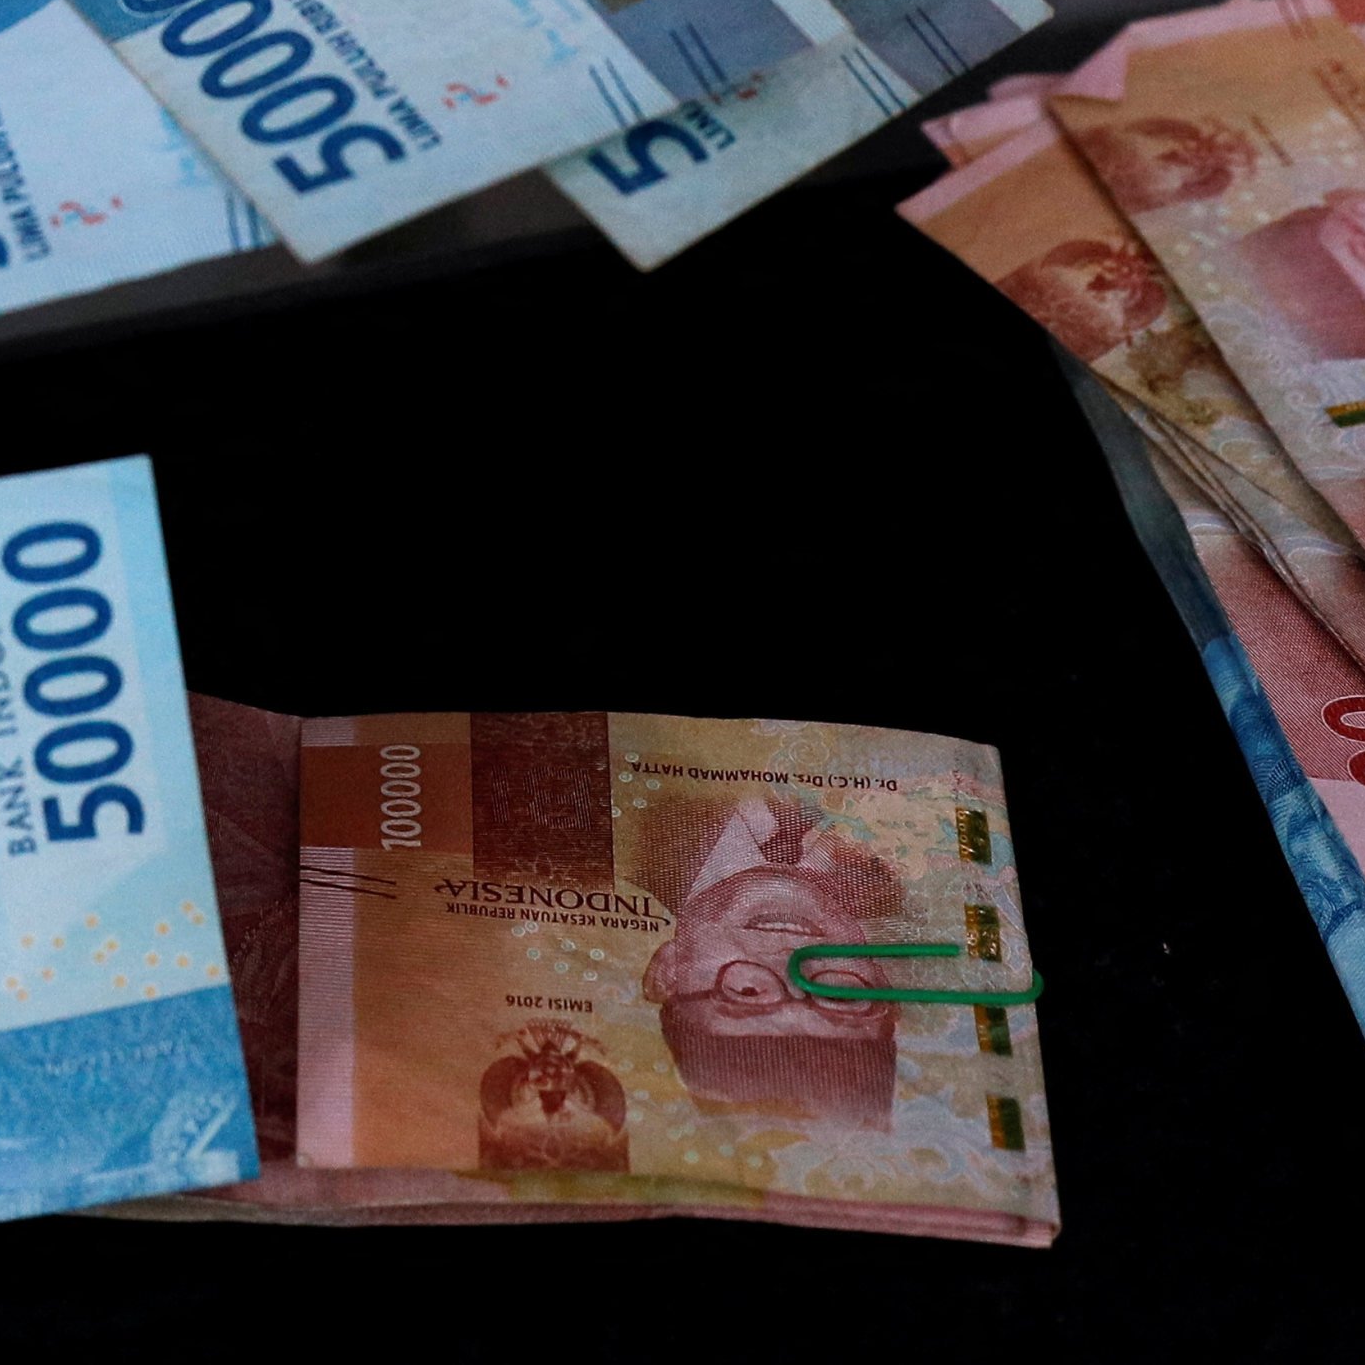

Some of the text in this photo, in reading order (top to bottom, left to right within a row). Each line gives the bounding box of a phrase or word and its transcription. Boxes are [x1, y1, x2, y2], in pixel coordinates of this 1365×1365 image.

[1, 521, 145, 843] 50000
[631, 762, 898, 791] Dr. (H.C.) Drs. MOHAMMAD HATTA
[380, 744, 422, 850] 100000
[434, 878, 671, 925] INDONESIA
[445, 902, 660, 933] NEGARA KESATUAN REPUBLIK
[505, 994, 593, 1013] EMISI 2016
